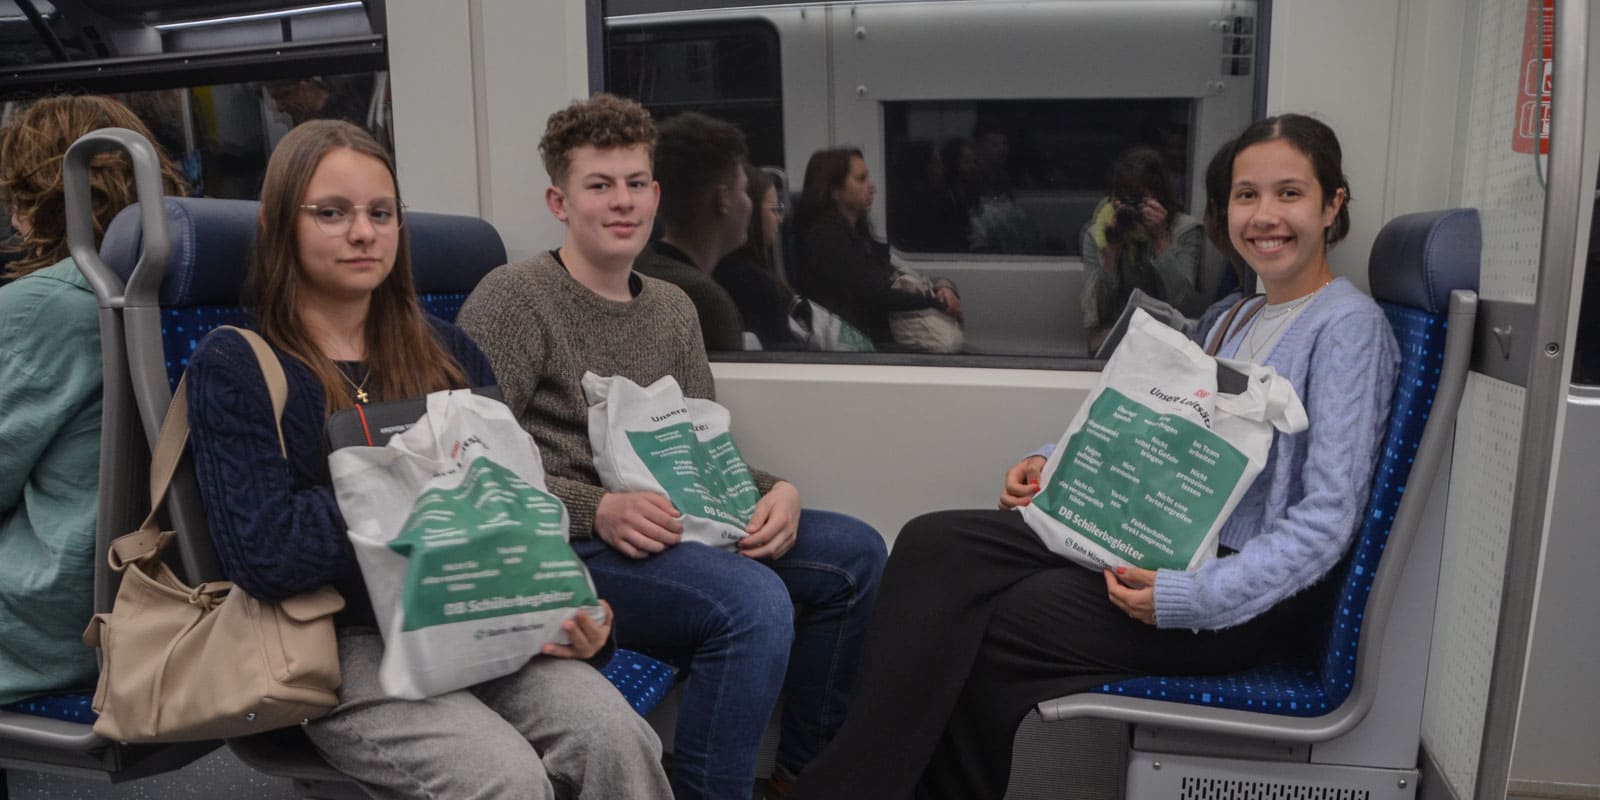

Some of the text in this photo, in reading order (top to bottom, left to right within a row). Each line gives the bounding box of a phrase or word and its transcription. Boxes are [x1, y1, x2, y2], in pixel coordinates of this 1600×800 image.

[651, 408, 688, 422] Unsere
[1135, 438, 1151, 450] selbst
[1158, 449, 1179, 464] Gefahr
[1151, 436, 1168, 449] Nicht
[1203, 445, 1220, 459] Team
[1141, 449, 1163, 465] bringen
[1189, 448, 1216, 465] arbeiten
[1176, 472, 1214, 495] provozieren
[1190, 468, 1208, 481] Nicht
[1181, 482, 1201, 497] lassen
[1145, 494, 1192, 524] Partei ergreifen
[1157, 491, 1188, 512] Nicht eine
[1058, 506, 1145, 561] DB Schülerbegleiter
[1121, 523, 1174, 556] direkt ansprechen
[1130, 518, 1172, 544] Fehlverhalten
[1072, 542, 1087, 554] Bahn
[1087, 549, 1112, 569] München
